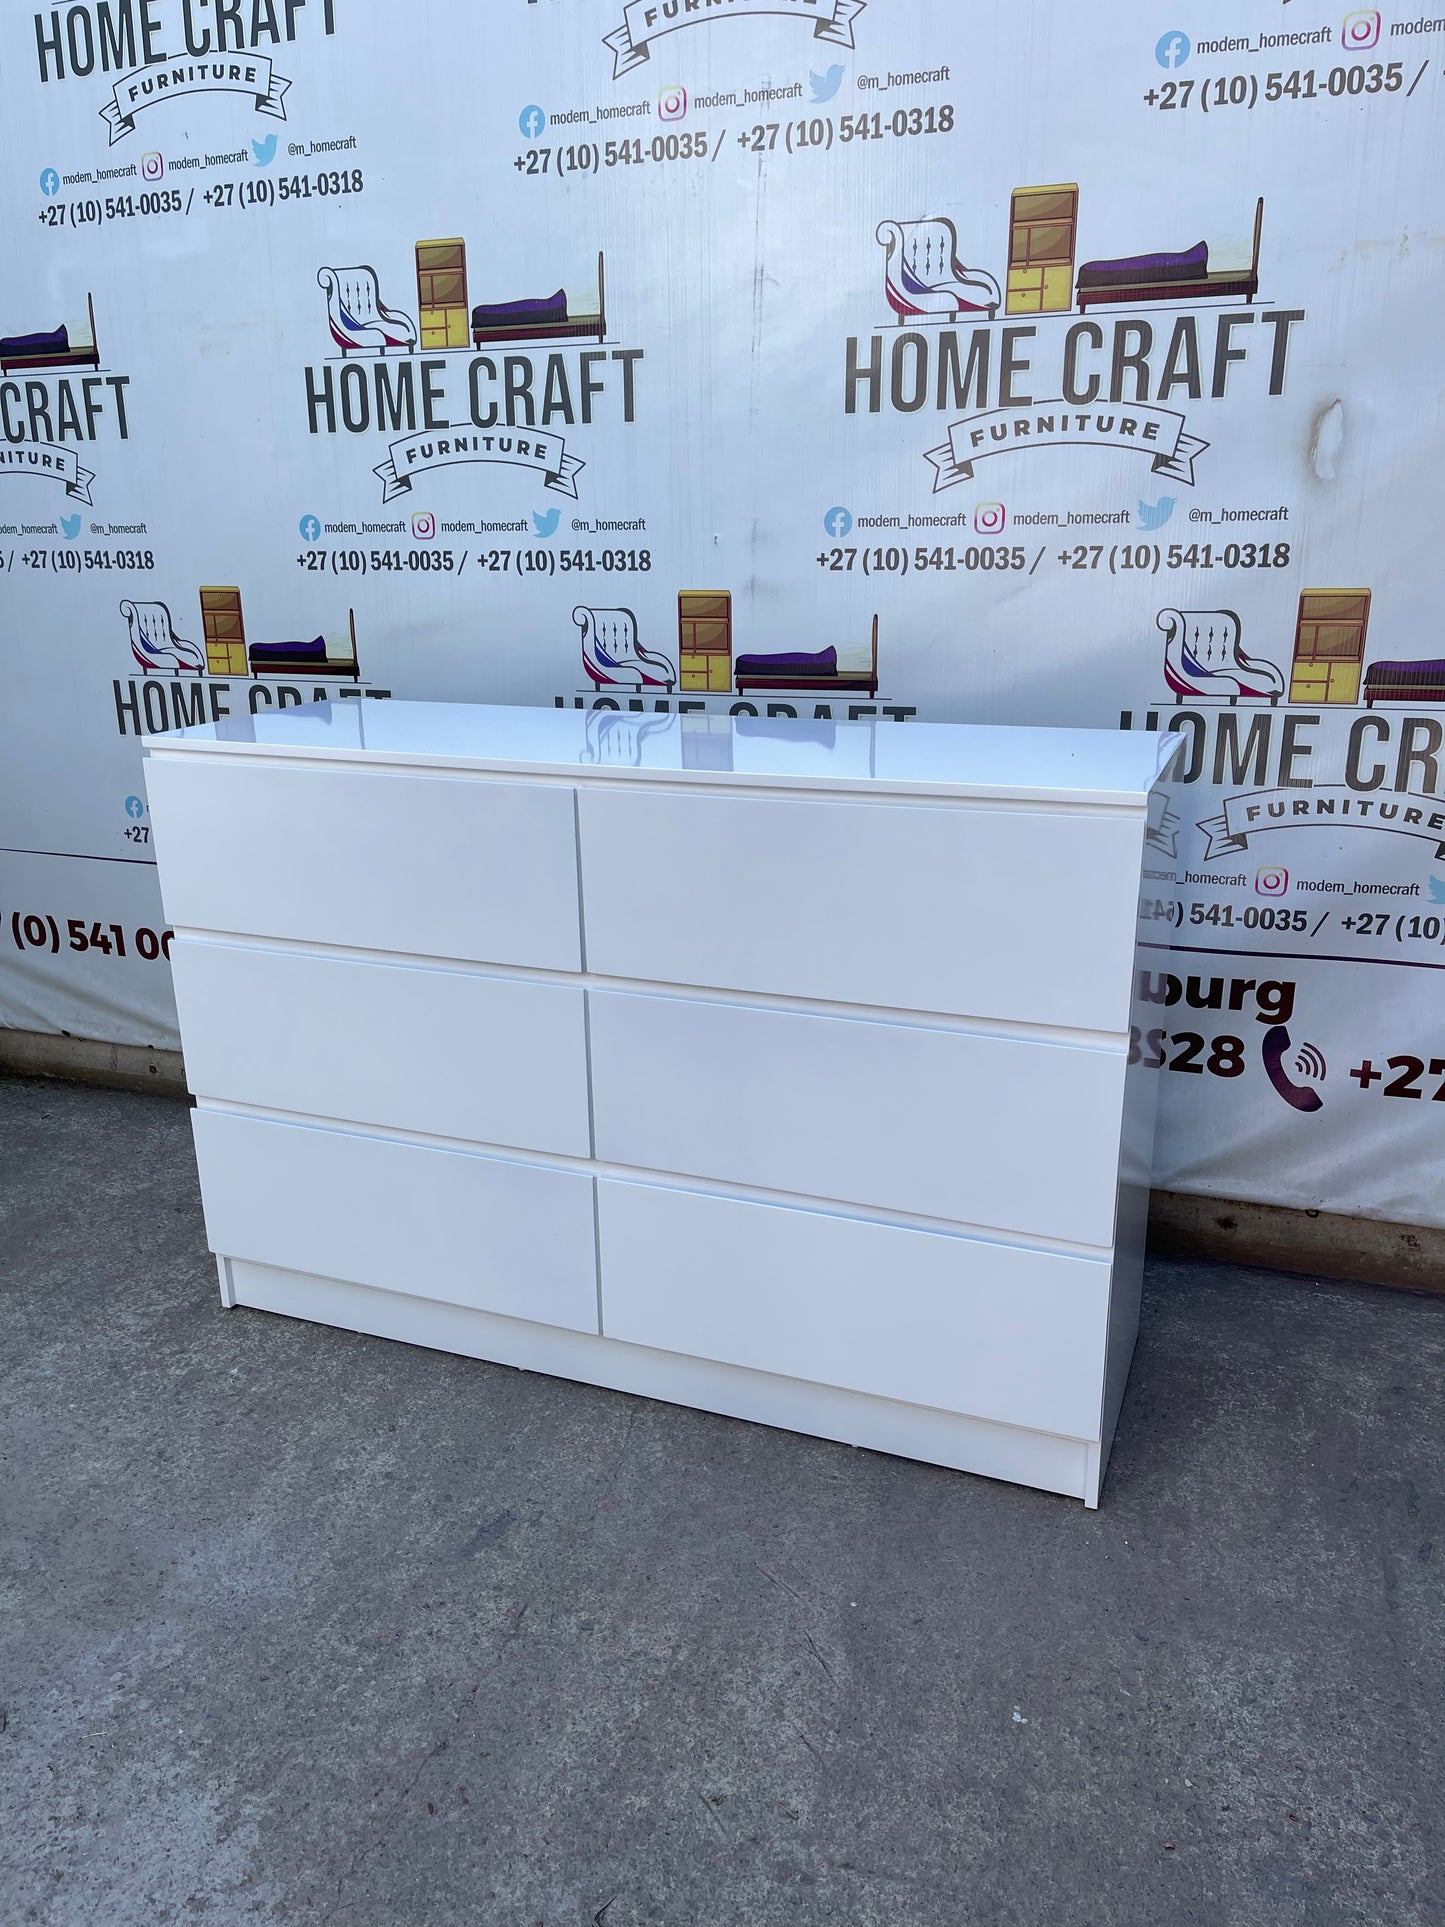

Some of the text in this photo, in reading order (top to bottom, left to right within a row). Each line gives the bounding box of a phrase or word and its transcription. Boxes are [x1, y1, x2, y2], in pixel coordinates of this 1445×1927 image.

[34, 0, 168, 83] HOME
[128, 64, 257, 102] FURNITURE
[857, 65, 951, 91] @m_homecraft
[1143, 79, 1195, 111] +27
[1200, 74, 1258, 113] (10)
[1264, 61, 1403, 102] 541-0035
[287, 135, 357, 157] @m_homecraft
[513, 148, 552, 175] +27
[556, 143, 600, 178] (10)
[604, 131, 708, 167] 541-0035
[737, 123, 780, 152] +27
[785, 117, 834, 154] (10)
[839, 104, 955, 143] 541-0318
[38, 204, 66, 227] +27
[70, 199, 102, 229] (10)
[105, 189, 182, 220] 541-0035
[203, 183, 234, 208] +27
[238, 179, 275, 210] (10)
[278, 168, 364, 201] 541-0318
[844, 309, 1306, 414] HOME CRAFT
[304, 349, 644, 433] HOME CRAFT
[0, 375, 130, 444] CRAFT
[969, 414, 1161, 447] FURNITURE
[405, 436, 548, 464] FURNITURE
[90, 522, 148, 536] @m_homecraft
[571, 517, 646, 534] @m_homecraft
[1188, 506, 1289, 525] @m_homecraft
[21, 549, 48, 569] +27
[51, 550, 82, 574] (10)
[84, 550, 155, 570] 541-0318
[296, 550, 327, 571] +27
[331, 550, 367, 576] (10)
[370, 550, 454, 571] 541-0035
[477, 550, 511, 571] +27
[516, 549, 555, 576] (10)
[559, 549, 652, 572] 541-0318
[816, 547, 858, 571] +27
[862, 547, 909, 576] (10)
[914, 546, 1026, 571] 541-0035
[1057, 545, 1104, 570] +27
[1109, 544, 1161, 575] (10)
[1166, 542, 1291, 569] 541-0318
[112, 679, 230, 736] HOME
[1120, 711, 1320, 789] OME
[1246, 798, 1445, 830] FURNITURE
[123, 825, 150, 844] +27
[11, 911, 60, 954] (0)
[67, 919, 127, 957] 541
[1189, 902, 1308, 932] 541-0035
[1341, 912, 1391, 936] +27
